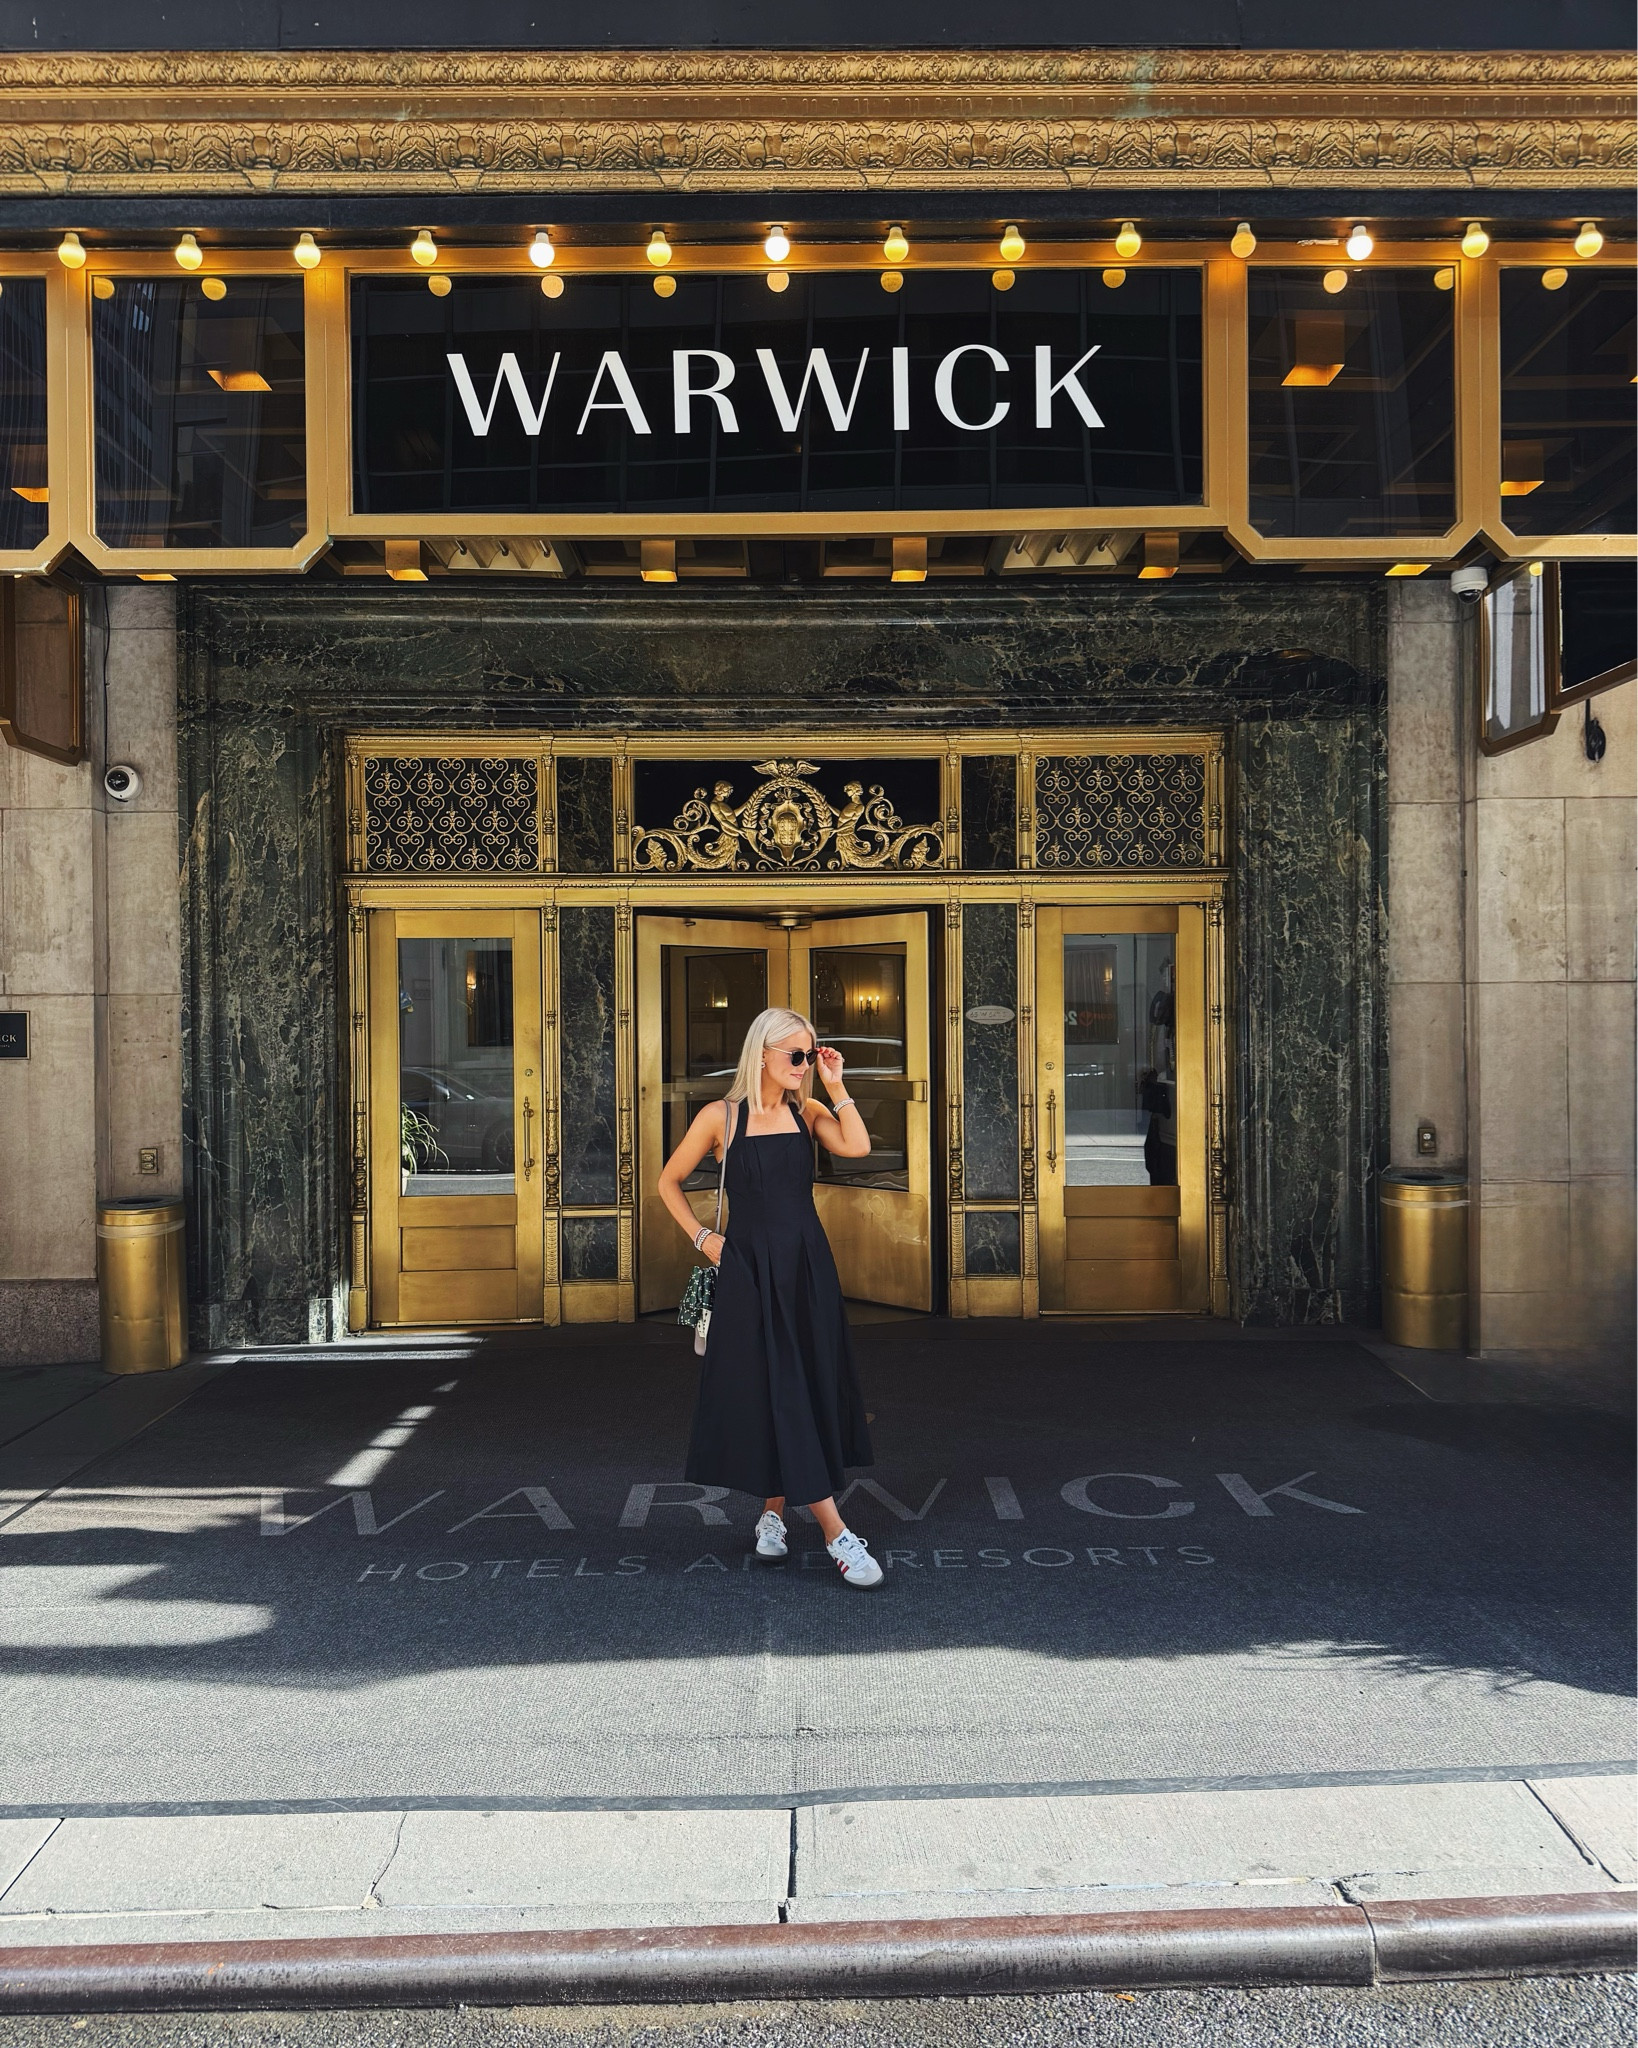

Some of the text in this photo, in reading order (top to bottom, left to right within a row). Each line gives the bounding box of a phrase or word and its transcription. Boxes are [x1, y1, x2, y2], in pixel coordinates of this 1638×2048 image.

[446, 344, 1106, 436] WARWICK
[0, 1034, 17, 1043] CK
[260, 1472, 1367, 1536] WARWICK
[357, 1555, 649, 1583] HOTELS
[885, 1546, 1216, 1569] RESORTS
